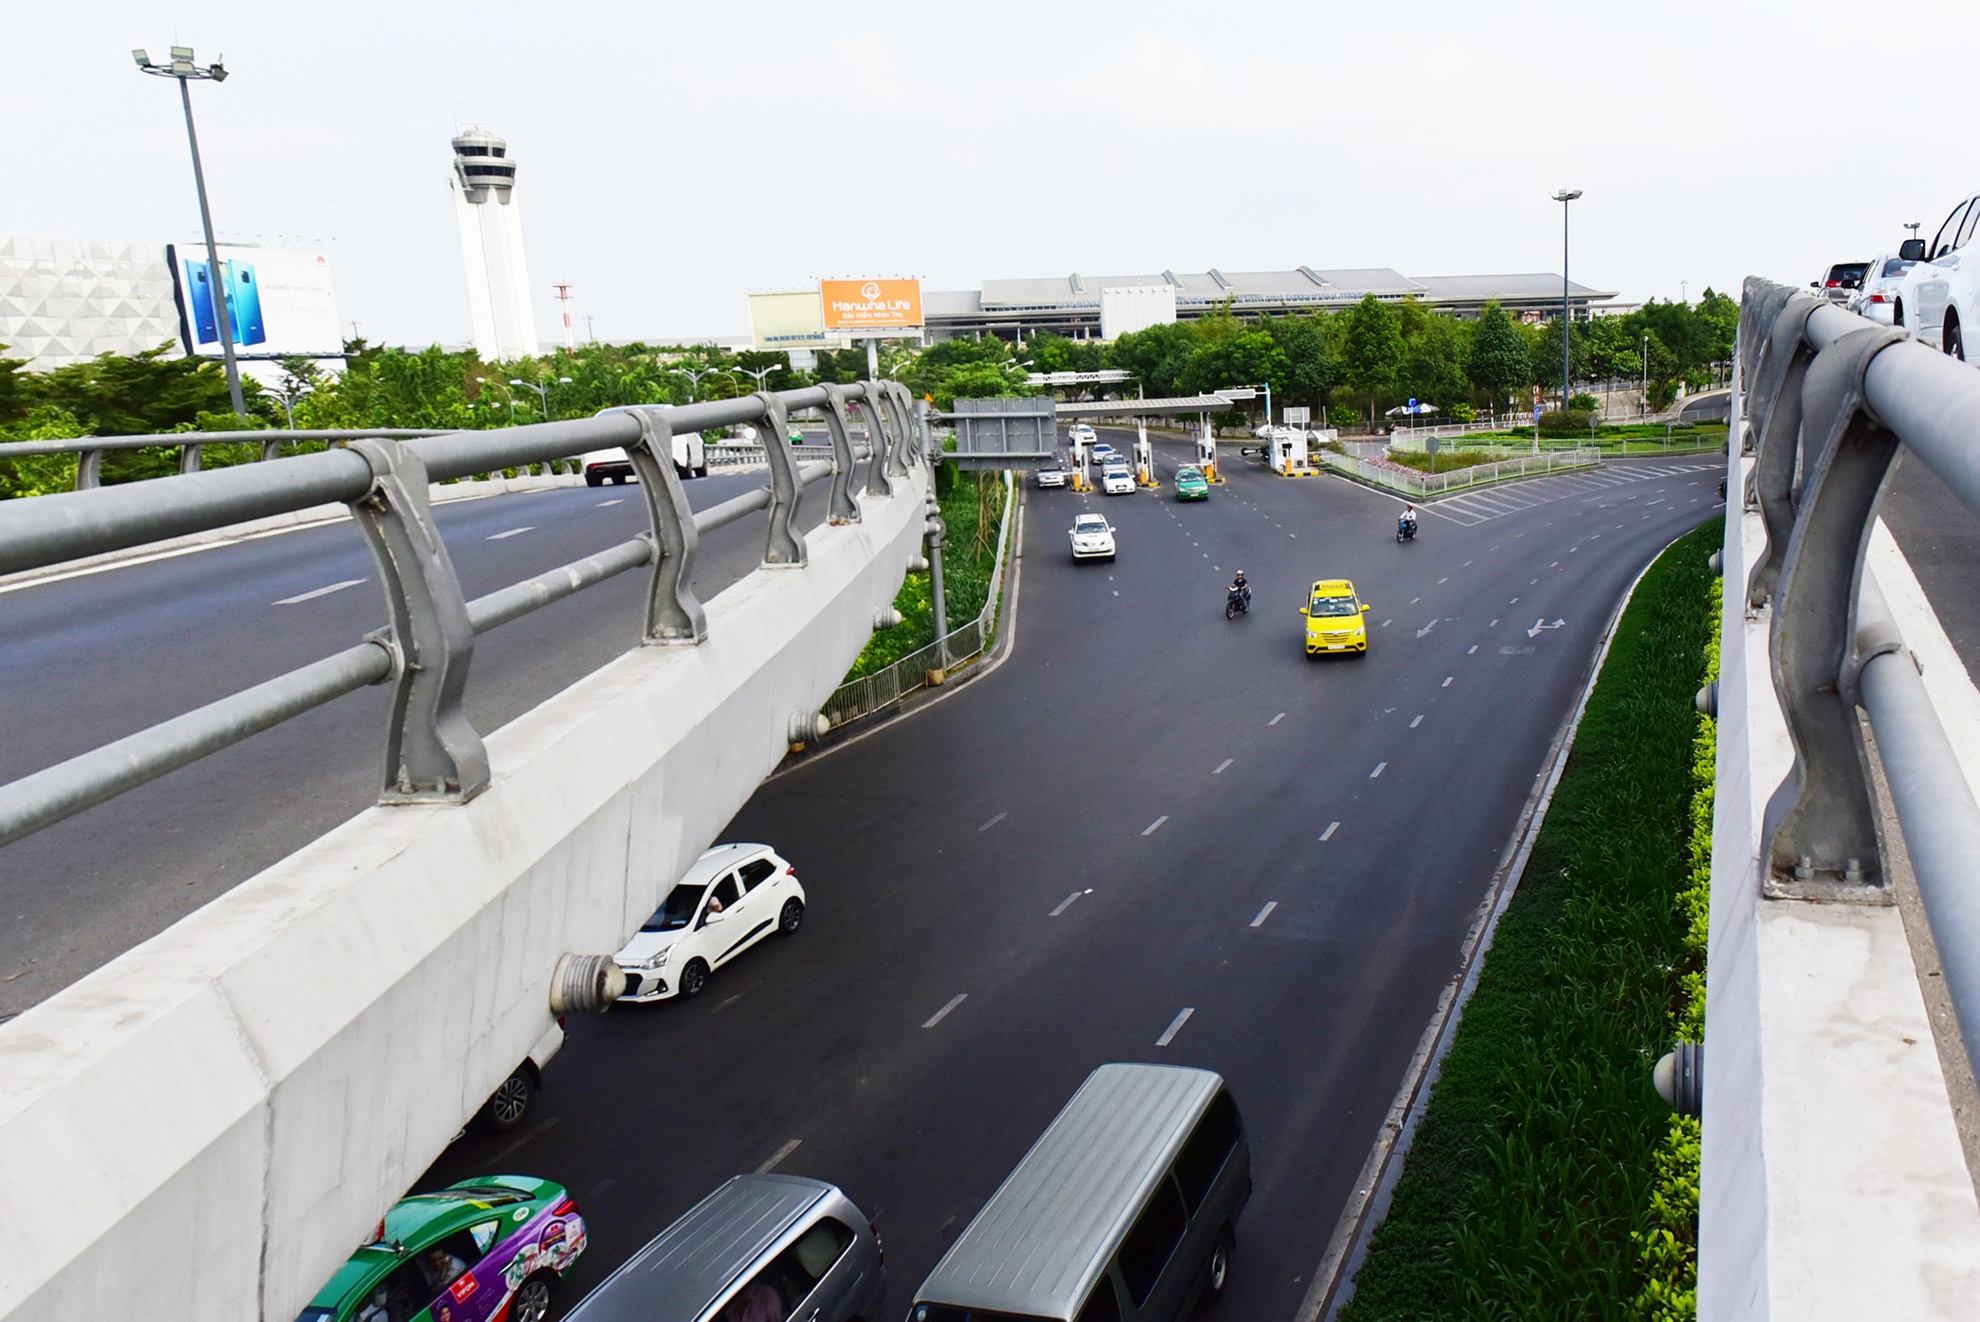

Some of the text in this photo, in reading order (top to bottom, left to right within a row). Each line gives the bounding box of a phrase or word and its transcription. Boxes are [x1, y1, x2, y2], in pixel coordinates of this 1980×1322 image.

[832, 299, 911, 311] Hanwha Life
[457, 1281, 475, 1297] VIFON
